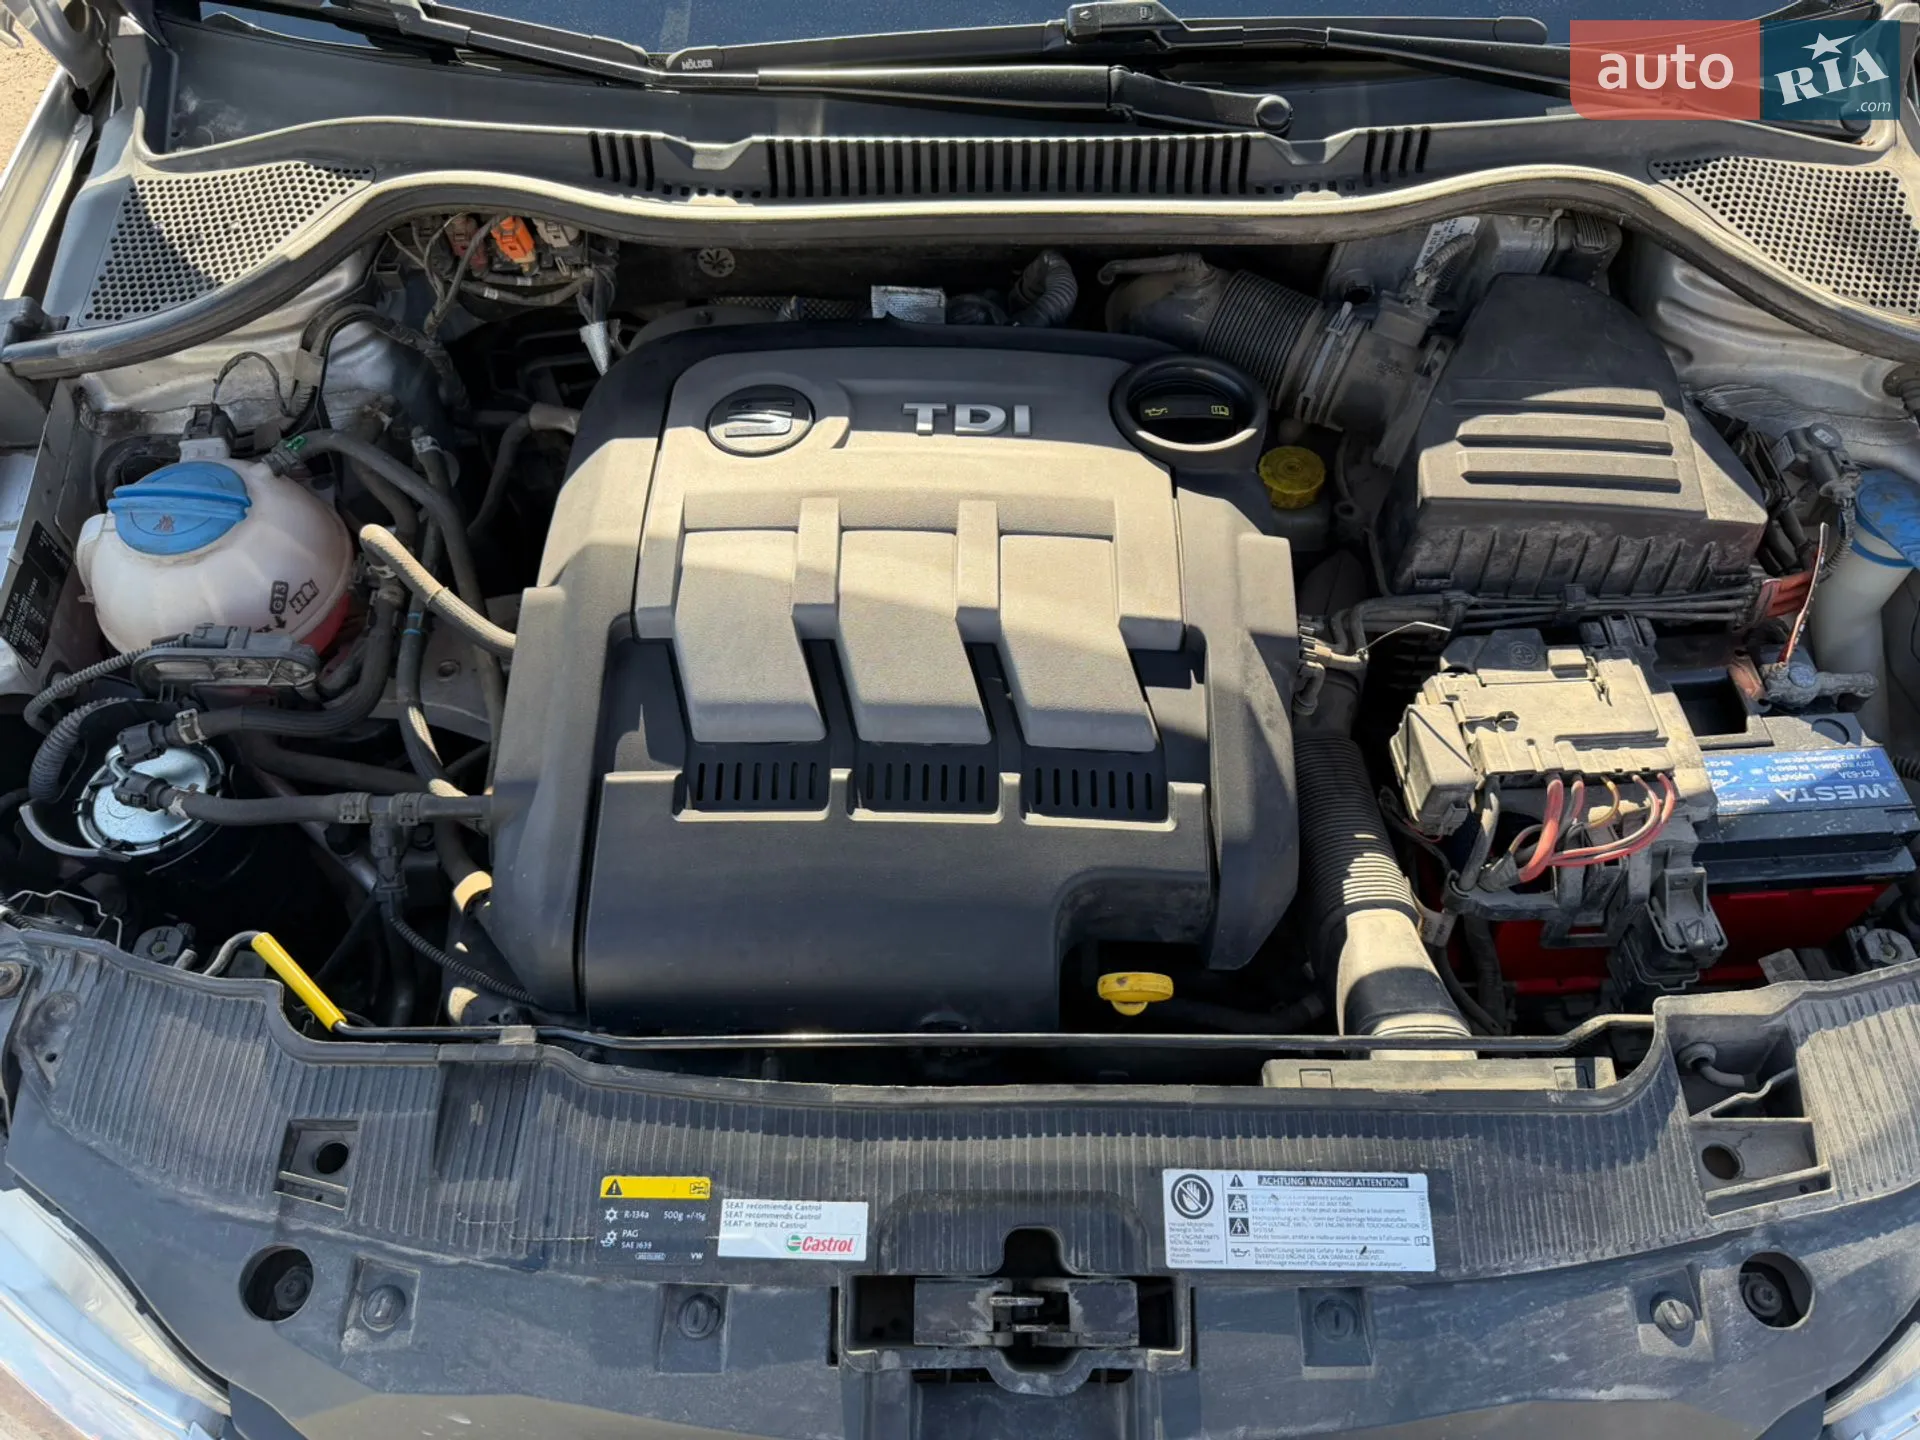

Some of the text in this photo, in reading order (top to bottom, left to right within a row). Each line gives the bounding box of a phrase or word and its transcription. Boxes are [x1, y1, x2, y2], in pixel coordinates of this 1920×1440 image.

[903, 403, 1031, 436] TDI
[1774, 783, 1891, 802] WESTA
[1261, 1177, 1405, 1188] ACHTUNG! WARNING! ATTENTION!
[725, 1201, 822, 1211] SEAT recomienda Castrol
[664, 1210, 683, 1222] 500g
[745, 1212, 792, 1220] recommends
[794, 1212, 822, 1220] Castrol
[780, 1222, 808, 1230] Castrol
[622, 1229, 638, 1237] PAG
[621, 1241, 634, 1249] SAE
[802, 1236, 853, 1252] Castrol
[690, 1252, 703, 1260] VW
